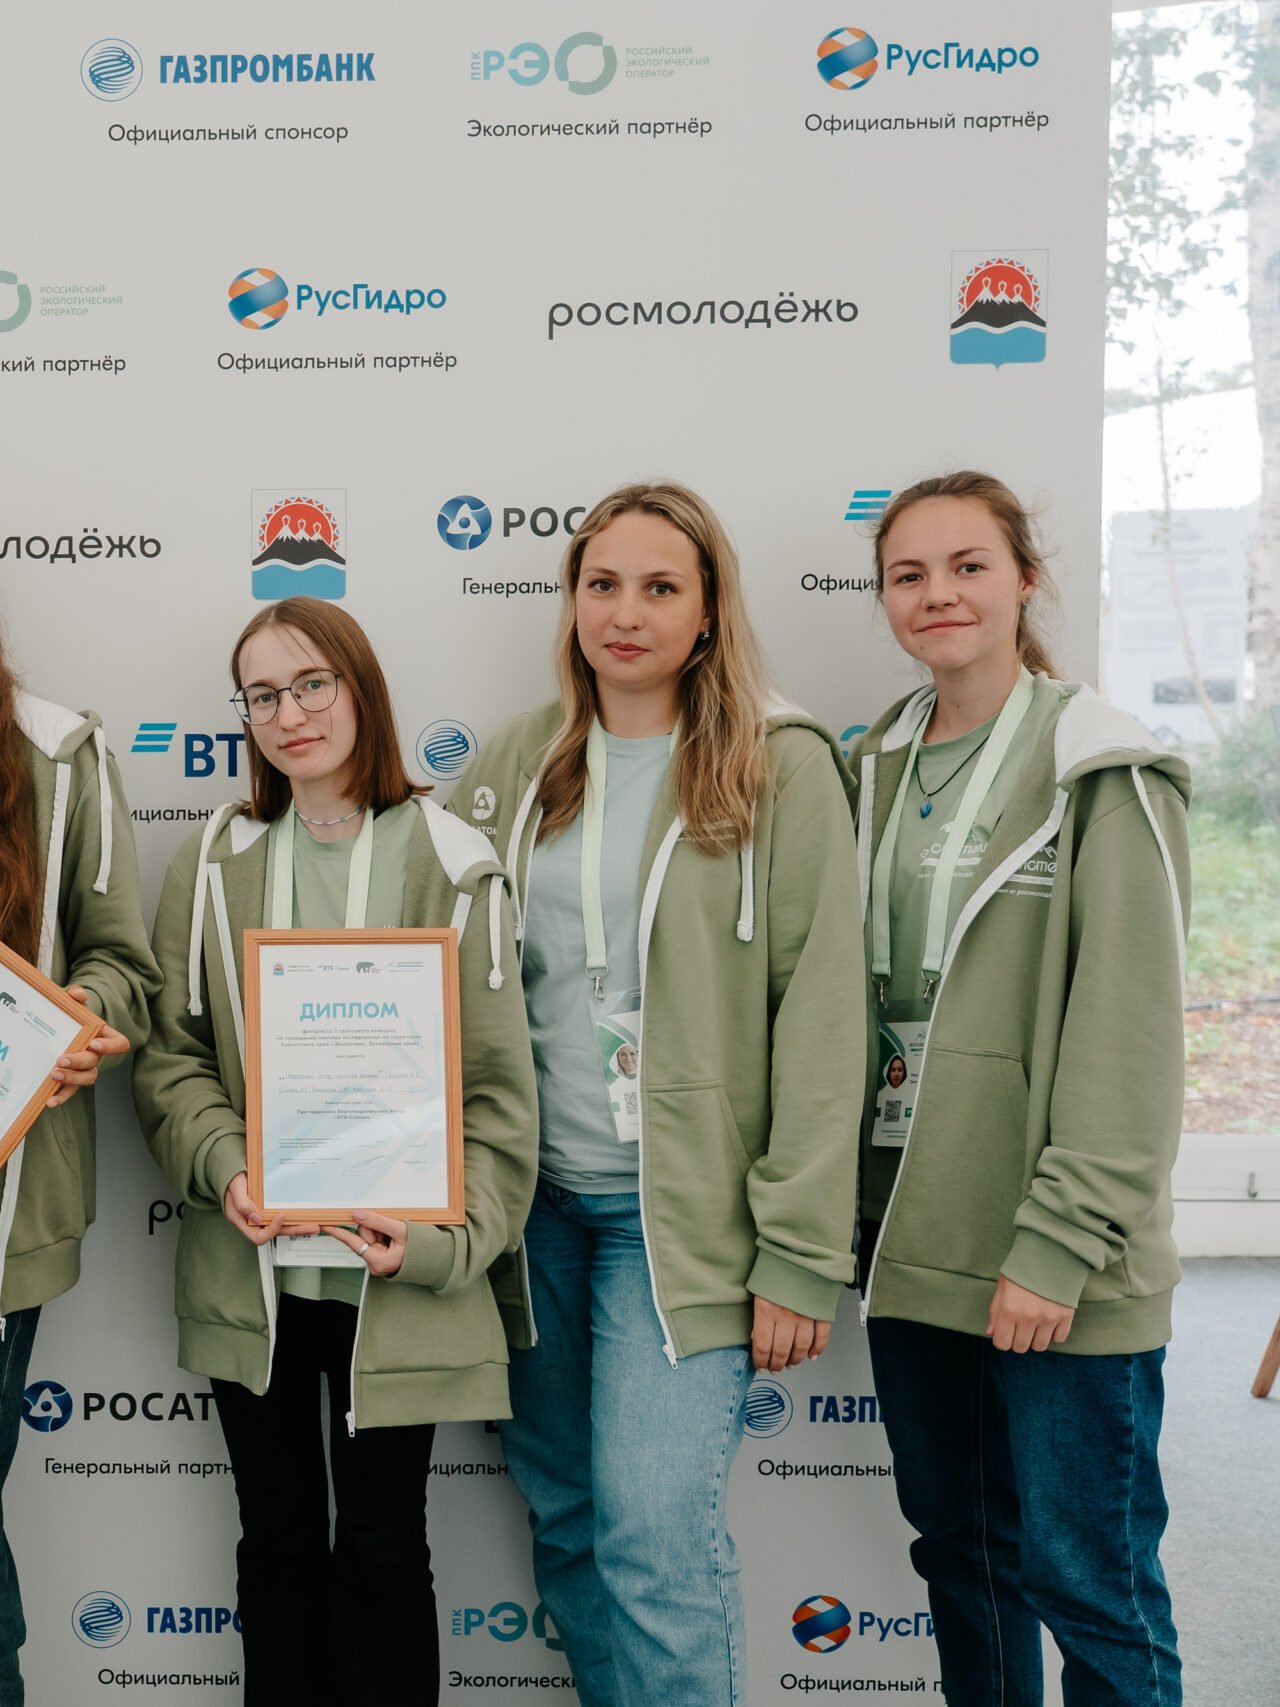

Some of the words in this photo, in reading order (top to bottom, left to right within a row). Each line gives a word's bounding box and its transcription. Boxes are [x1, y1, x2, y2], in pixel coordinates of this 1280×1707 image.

[625, 46, 692, 56] РОССИЙСКИЙ
[887, 43, 1039, 76] РусГидро
[160, 53, 375, 83] ГАЗПРОМБАНК
[625, 57, 710, 68] ЭКОЛОГИЧЕСКИЙ
[625, 69, 676, 78] ОПЕРАТОР
[468, 120, 619, 137] Экологический
[628, 118, 712, 138] партнёр
[805, 113, 955, 135] Официальный
[964, 111, 1049, 132] партнёр
[109, 124, 256, 145] Официальный
[265, 127, 348, 143] спонсор
[40, 284, 106, 294] РОССИЙСКИЙ
[40, 295, 123, 305] ЭКОЛОГИЧЕСКИЙ
[297, 284, 446, 316] РусГидро
[40, 306, 89, 316] ОПЕРАТОР
[549, 292, 858, 340] росмолодёжь
[43, 355, 126, 375] партнёр
[218, 353, 365, 374] Официальный
[374, 352, 457, 372] партнёр
[462, 577, 563, 598] Генеральн
[801, 573, 879, 595] Официа
[184, 733, 246, 778] ВТ
[130, 808, 214, 824] ициальн
[299, 1002, 400, 1021] ДИПЛОМ
[83, 1392, 216, 1422] РОСАТ
[45, 1457, 170, 1478] Генеральный
[178, 1462, 233, 1478] партн
[428, 1463, 509, 1477] ициальн
[757, 1459, 895, 1480] Официальны
[147, 1606, 242, 1634] ГАЗПРО
[859, 1611, 935, 1642] РусГ
[98, 1668, 240, 1689] Официальный
[448, 1671, 576, 1689] Экологическ
[780, 1673, 926, 1694] Официальный
